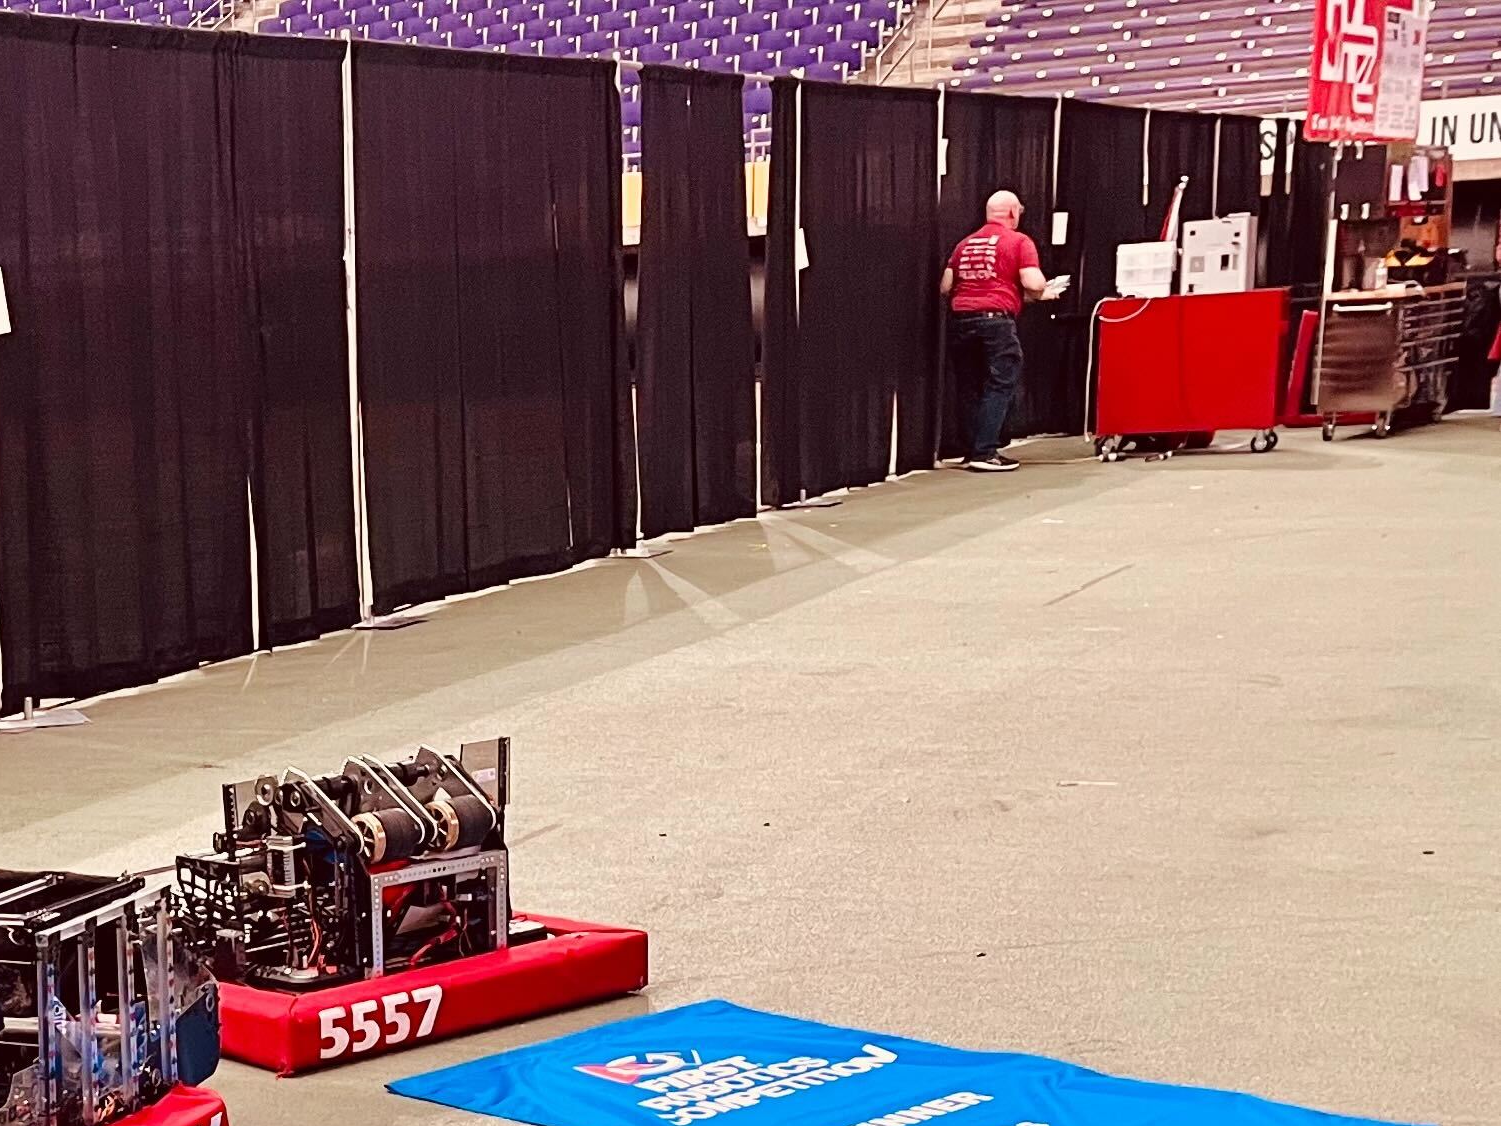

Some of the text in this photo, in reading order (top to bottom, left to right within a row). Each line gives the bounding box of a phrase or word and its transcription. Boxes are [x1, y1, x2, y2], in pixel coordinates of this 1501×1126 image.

[1431, 115, 1458, 146] IN
[319, 985, 443, 1060] 5557
[637, 1056, 830, 1110] ROBOTICS
